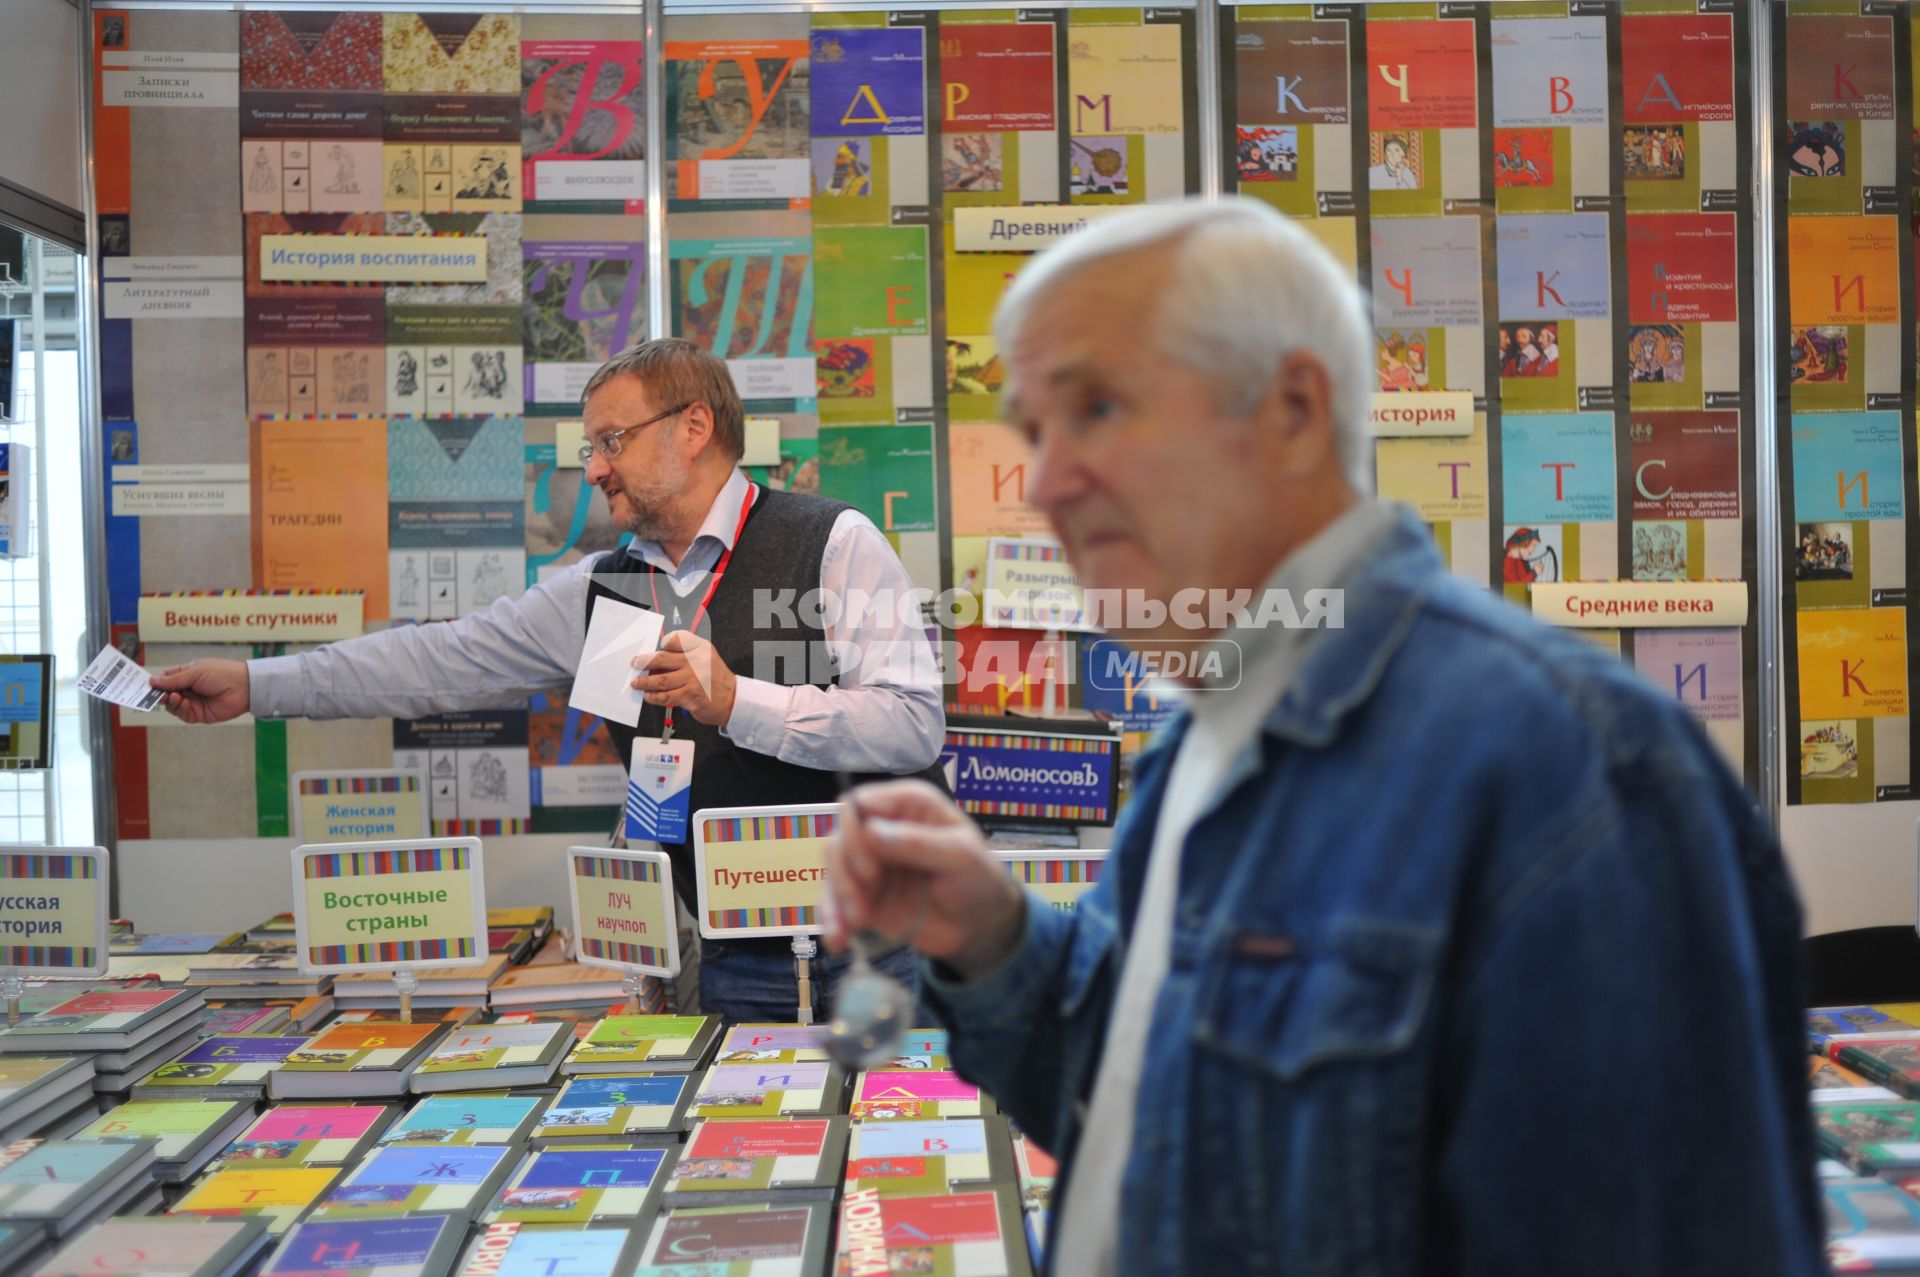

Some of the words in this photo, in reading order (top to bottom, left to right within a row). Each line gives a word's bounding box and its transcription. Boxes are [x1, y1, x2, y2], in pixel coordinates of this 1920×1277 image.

[989, 217, 1088, 242] Древний
[271, 249, 354, 268] История
[360, 251, 476, 270] воспитания
[1368, 408, 1456, 426] история
[1566, 594, 1662, 617] Средние
[1664, 600, 1715, 613] века
[164, 611, 241, 628] Вечные
[245, 611, 339, 629] спутники
[325, 804, 396, 818] Женская
[328, 821, 395, 837] история
[323, 889, 448, 909] Восточные
[346, 914, 428, 934] страны
[597, 915, 647, 934] научпоп
